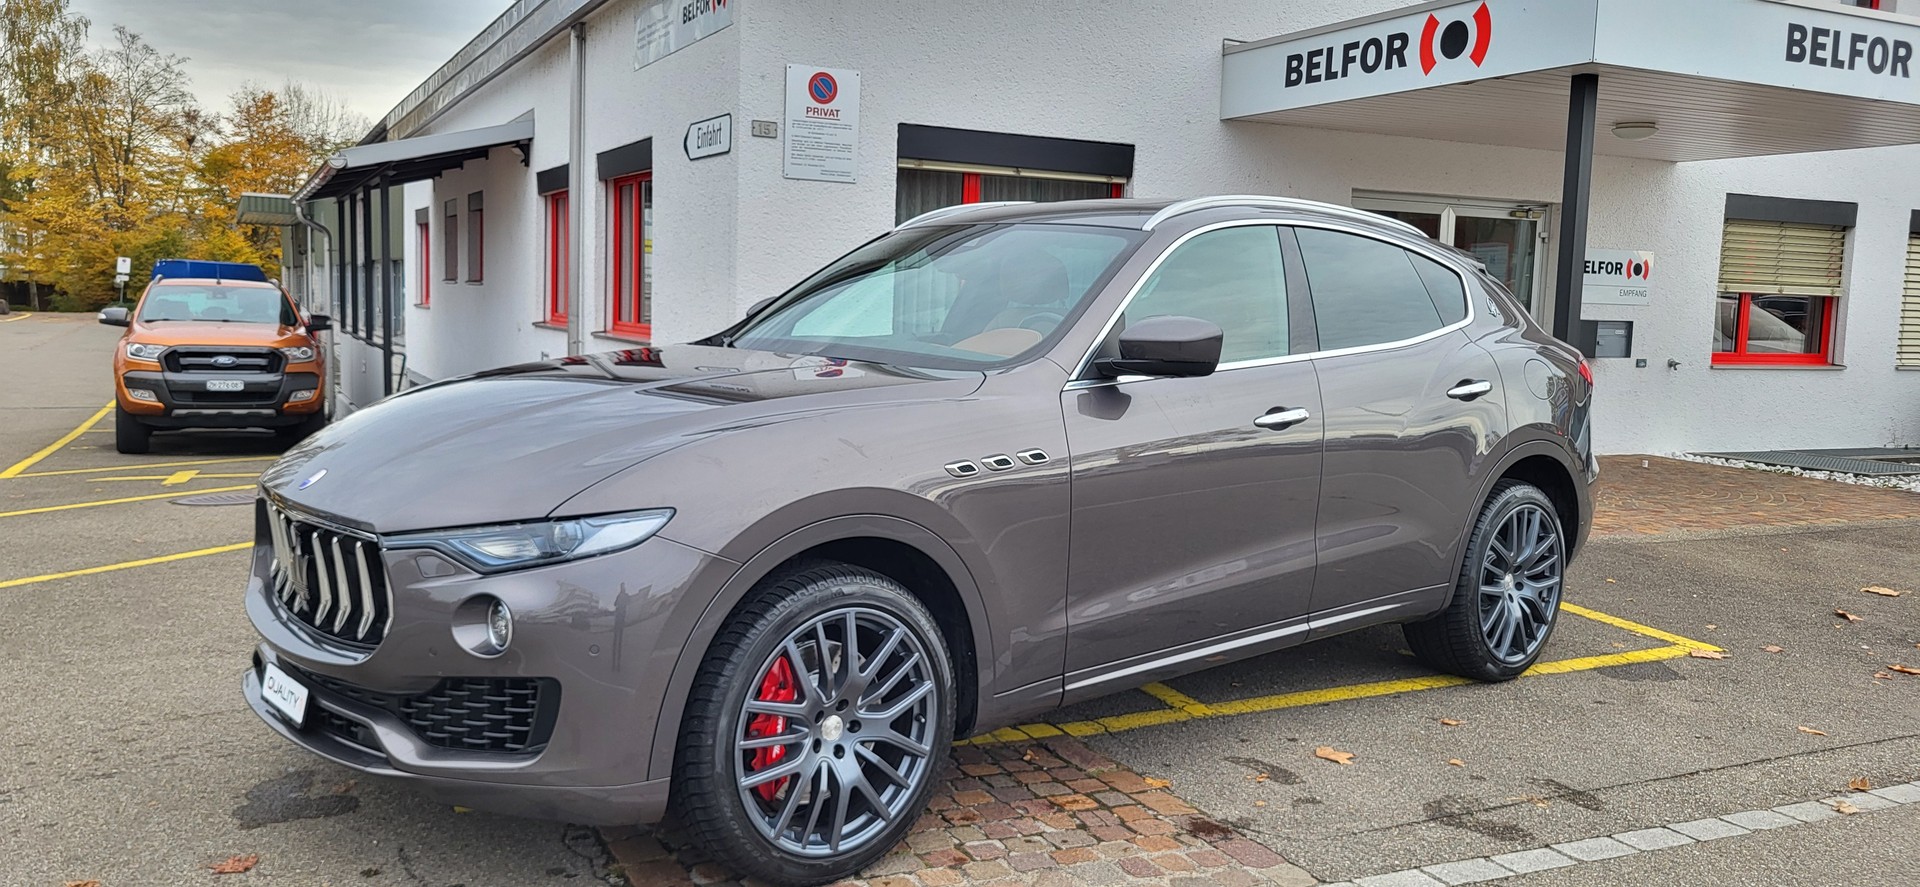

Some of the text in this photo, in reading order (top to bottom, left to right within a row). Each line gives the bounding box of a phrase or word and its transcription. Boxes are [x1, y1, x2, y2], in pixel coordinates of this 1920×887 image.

[1785, 22, 1912, 78] BELFOR
[1284, 32, 1409, 88] BELFOR
[806, 106, 840, 118] PRIVAT
[697, 122, 722, 149] Einfahrt
[758, 123, 771, 135] 15
[1584, 260, 1623, 275] ELFOR
[1619, 289, 1647, 297] EMPFANG
